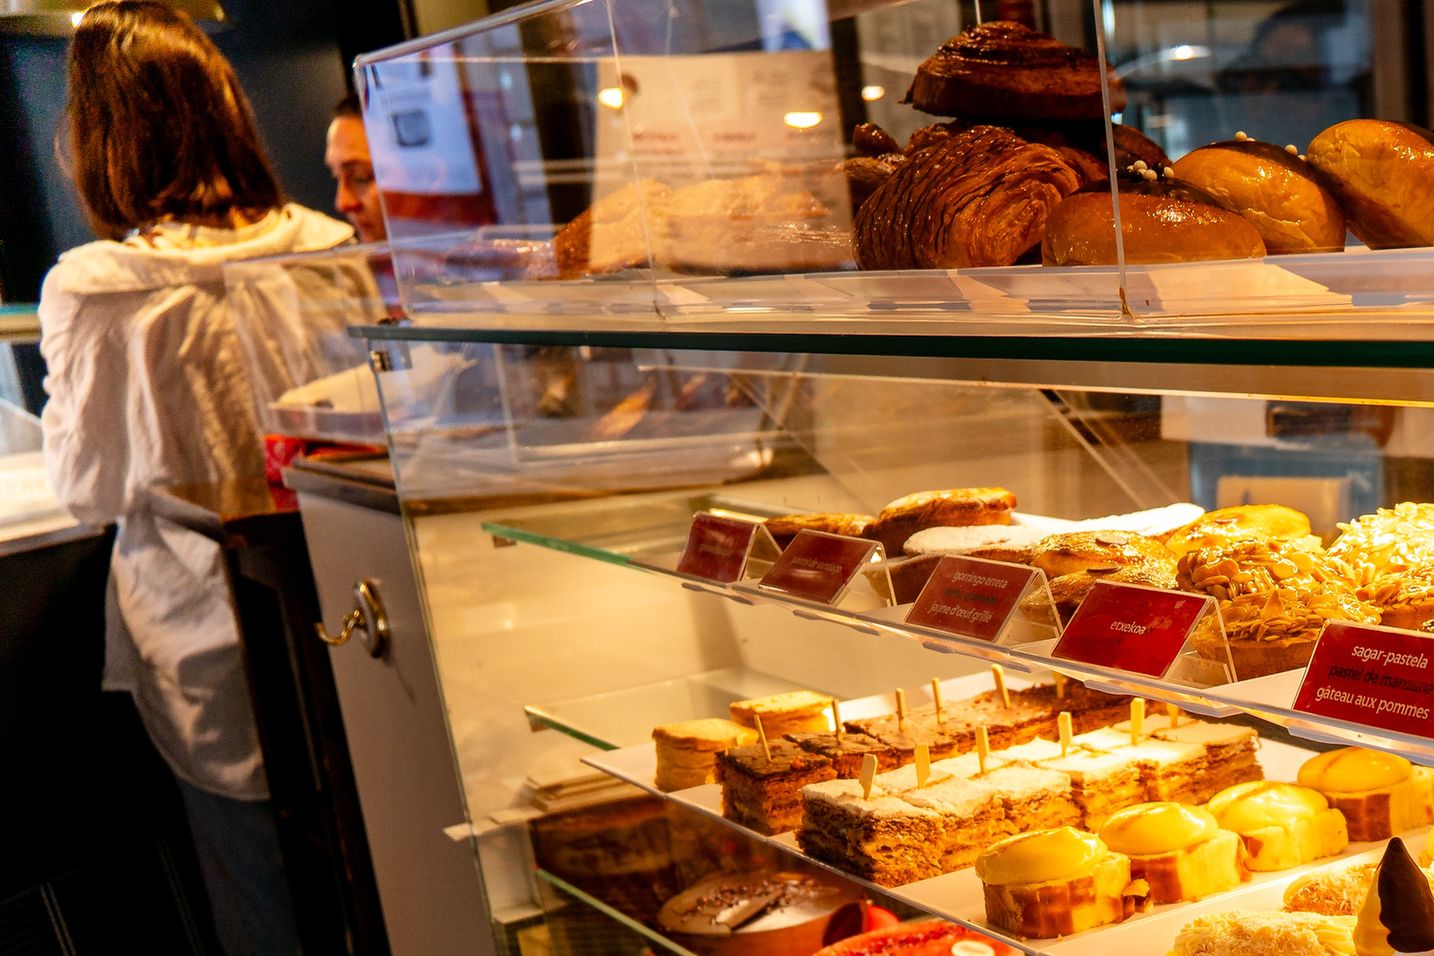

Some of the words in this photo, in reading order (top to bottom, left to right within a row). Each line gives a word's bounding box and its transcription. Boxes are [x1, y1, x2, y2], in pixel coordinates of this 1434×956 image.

[1110, 620, 1147, 635] etxekoa
[1351, 643, 1429, 669] sagar-pastela
[1315, 685, 1354, 705] gâteau
[1354, 693, 1376, 709] aux
[1376, 698, 1430, 720] pommes
